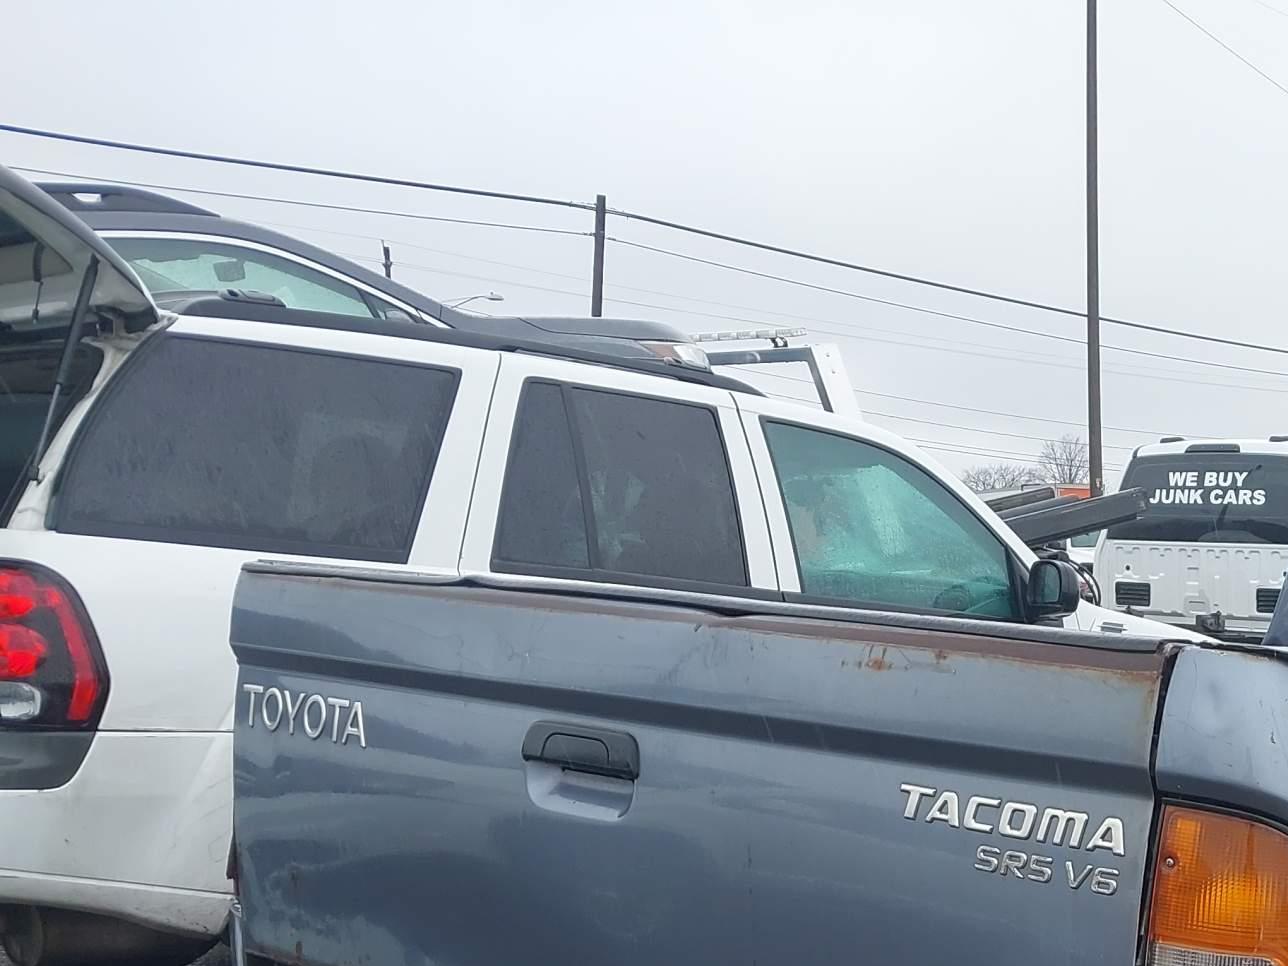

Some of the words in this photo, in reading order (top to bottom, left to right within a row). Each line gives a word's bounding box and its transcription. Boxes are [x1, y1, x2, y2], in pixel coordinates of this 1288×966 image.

[1149, 489, 1204, 504] JUNK
[1209, 489, 1266, 505] CARS
[1168, 471, 1199, 487] WE
[1203, 471, 1249, 487] BUY
[243, 684, 366, 748] TOYOTA
[900, 783, 1125, 856] TACOMA
[974, 845, 1053, 883] SR5
[1065, 860, 1119, 895] V6
